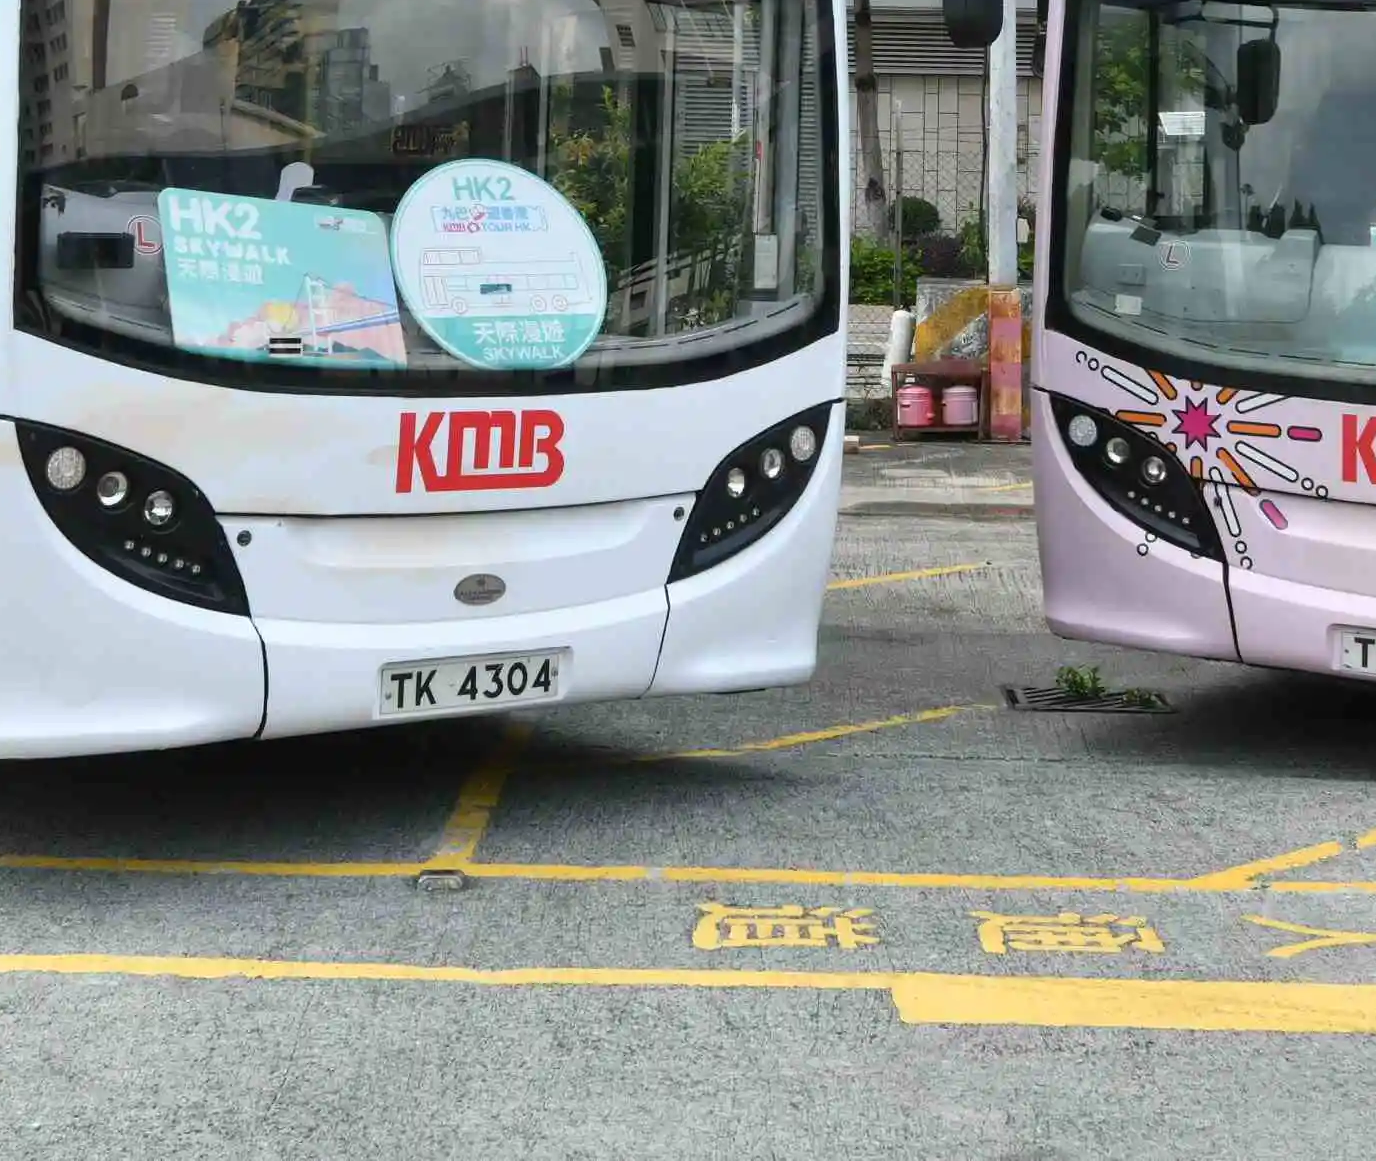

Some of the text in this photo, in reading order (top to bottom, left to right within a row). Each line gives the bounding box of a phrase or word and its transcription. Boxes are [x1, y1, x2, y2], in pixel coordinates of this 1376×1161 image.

[452, 176, 515, 201] HK2
[169, 195, 263, 240] HK2
[514, 222, 531, 231] HK
[136, 221, 155, 247] L
[174, 234, 292, 266] SKYWALK
[471, 319, 567, 344] 天際漫遊
[483, 345, 566, 361] SKYWALK
[395, 409, 565, 494] KMB
[390, 657, 552, 710] TK 4304
